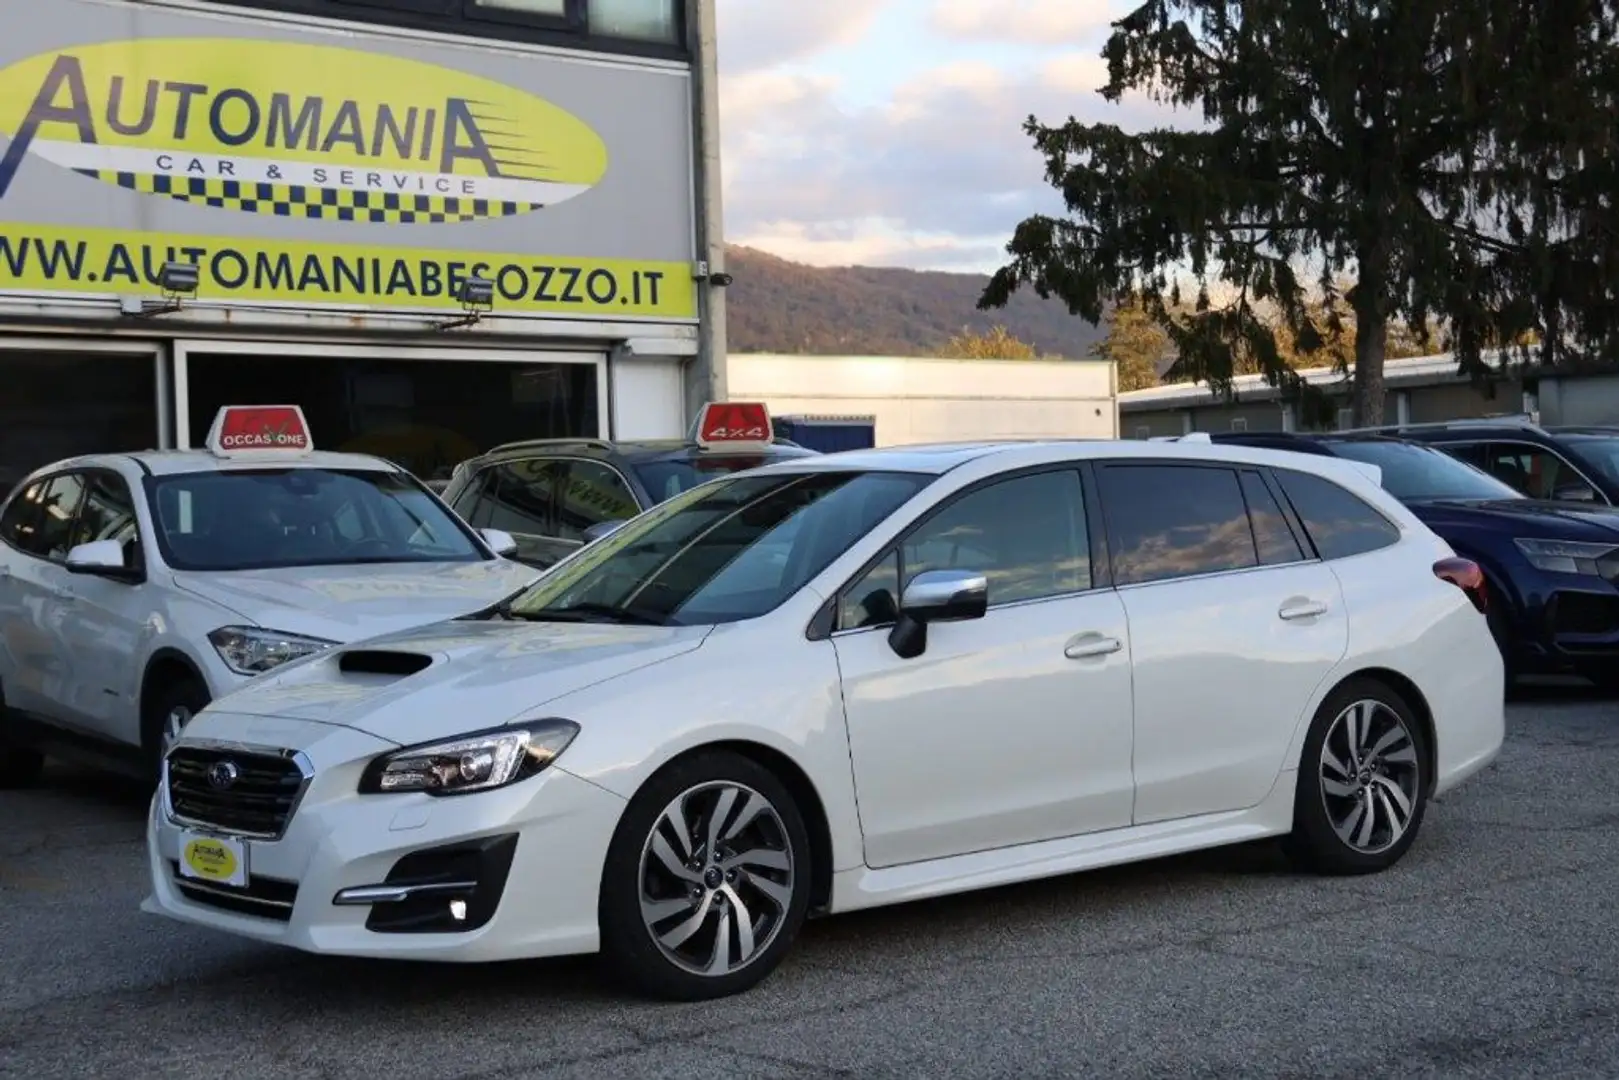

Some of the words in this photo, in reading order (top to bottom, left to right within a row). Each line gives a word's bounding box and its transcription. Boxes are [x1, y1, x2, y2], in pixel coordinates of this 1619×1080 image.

[0, 55, 501, 199] AUTOMANIA
[156, 155, 234, 175] CAR
[266, 164, 282, 180] &
[313, 168, 476, 194] SERVICE
